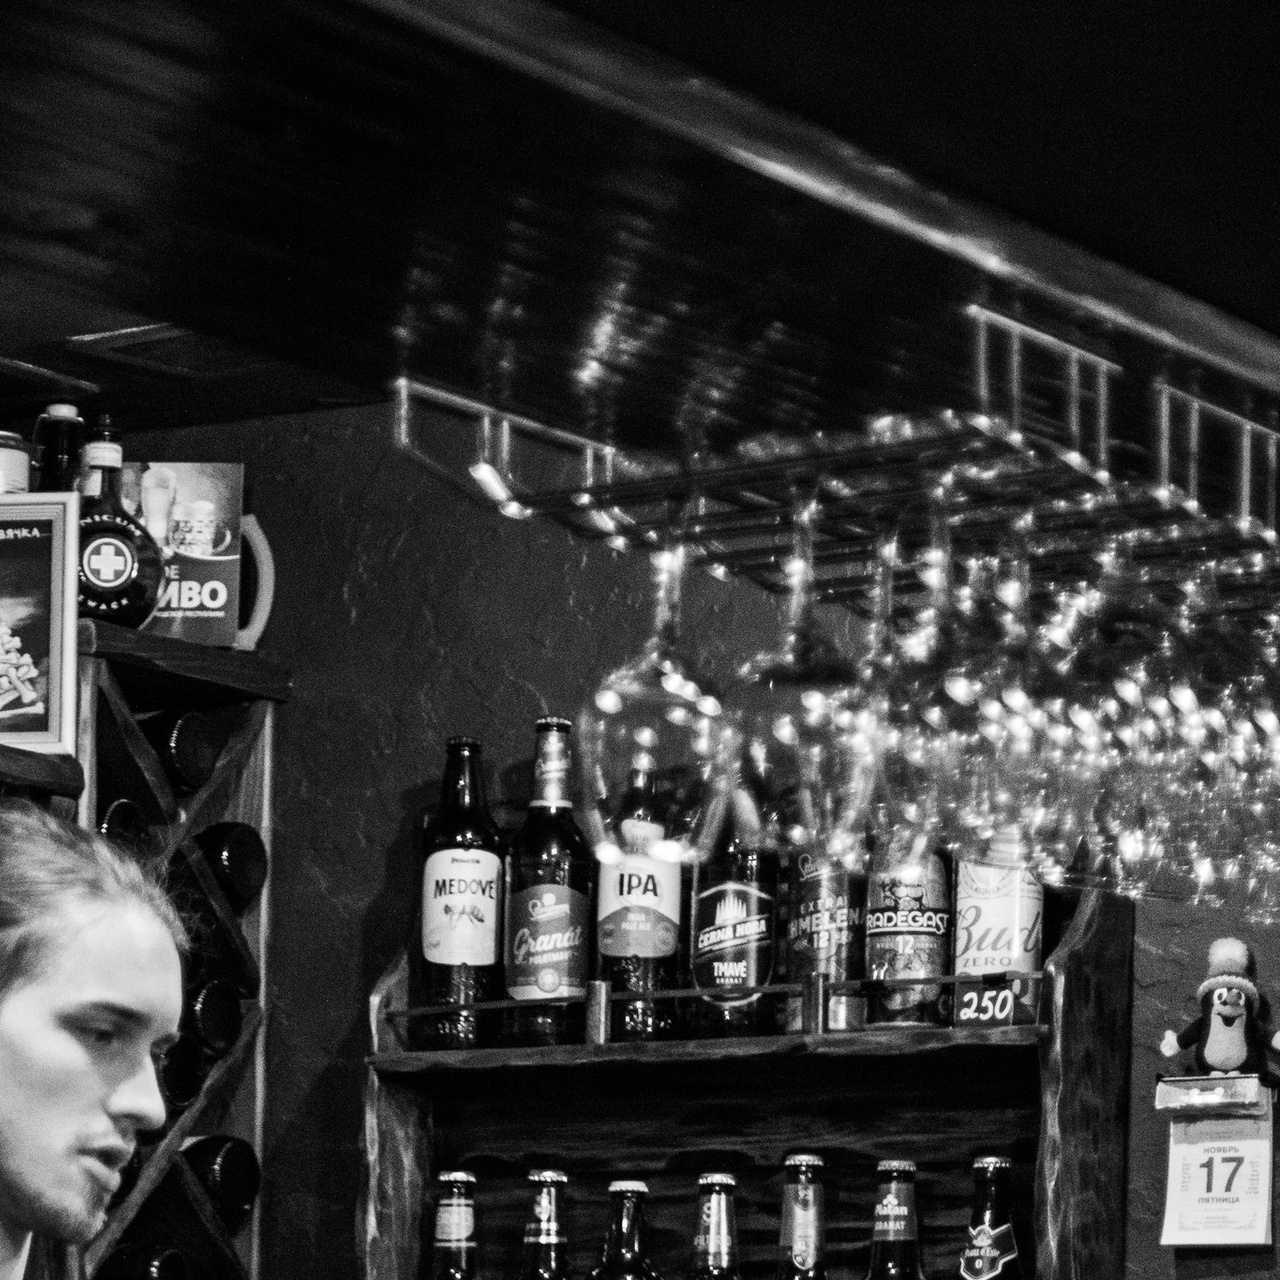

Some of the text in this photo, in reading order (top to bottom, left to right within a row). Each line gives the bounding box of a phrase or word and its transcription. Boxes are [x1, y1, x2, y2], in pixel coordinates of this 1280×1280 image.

[619, 873, 658, 897] IPA
[867, 911, 949, 934] RADEGAST
[954, 905, 1041, 958] Bud
[896, 935, 915, 954] 12
[962, 956, 1012, 968] ZERO
[959, 989, 1013, 1020] 250
[1204, 1146, 1240, 1154] НОЯБРЬ
[1199, 1156, 1245, 1194] 17
[1198, 1196, 1240, 1204] ПЯТНИЦА
